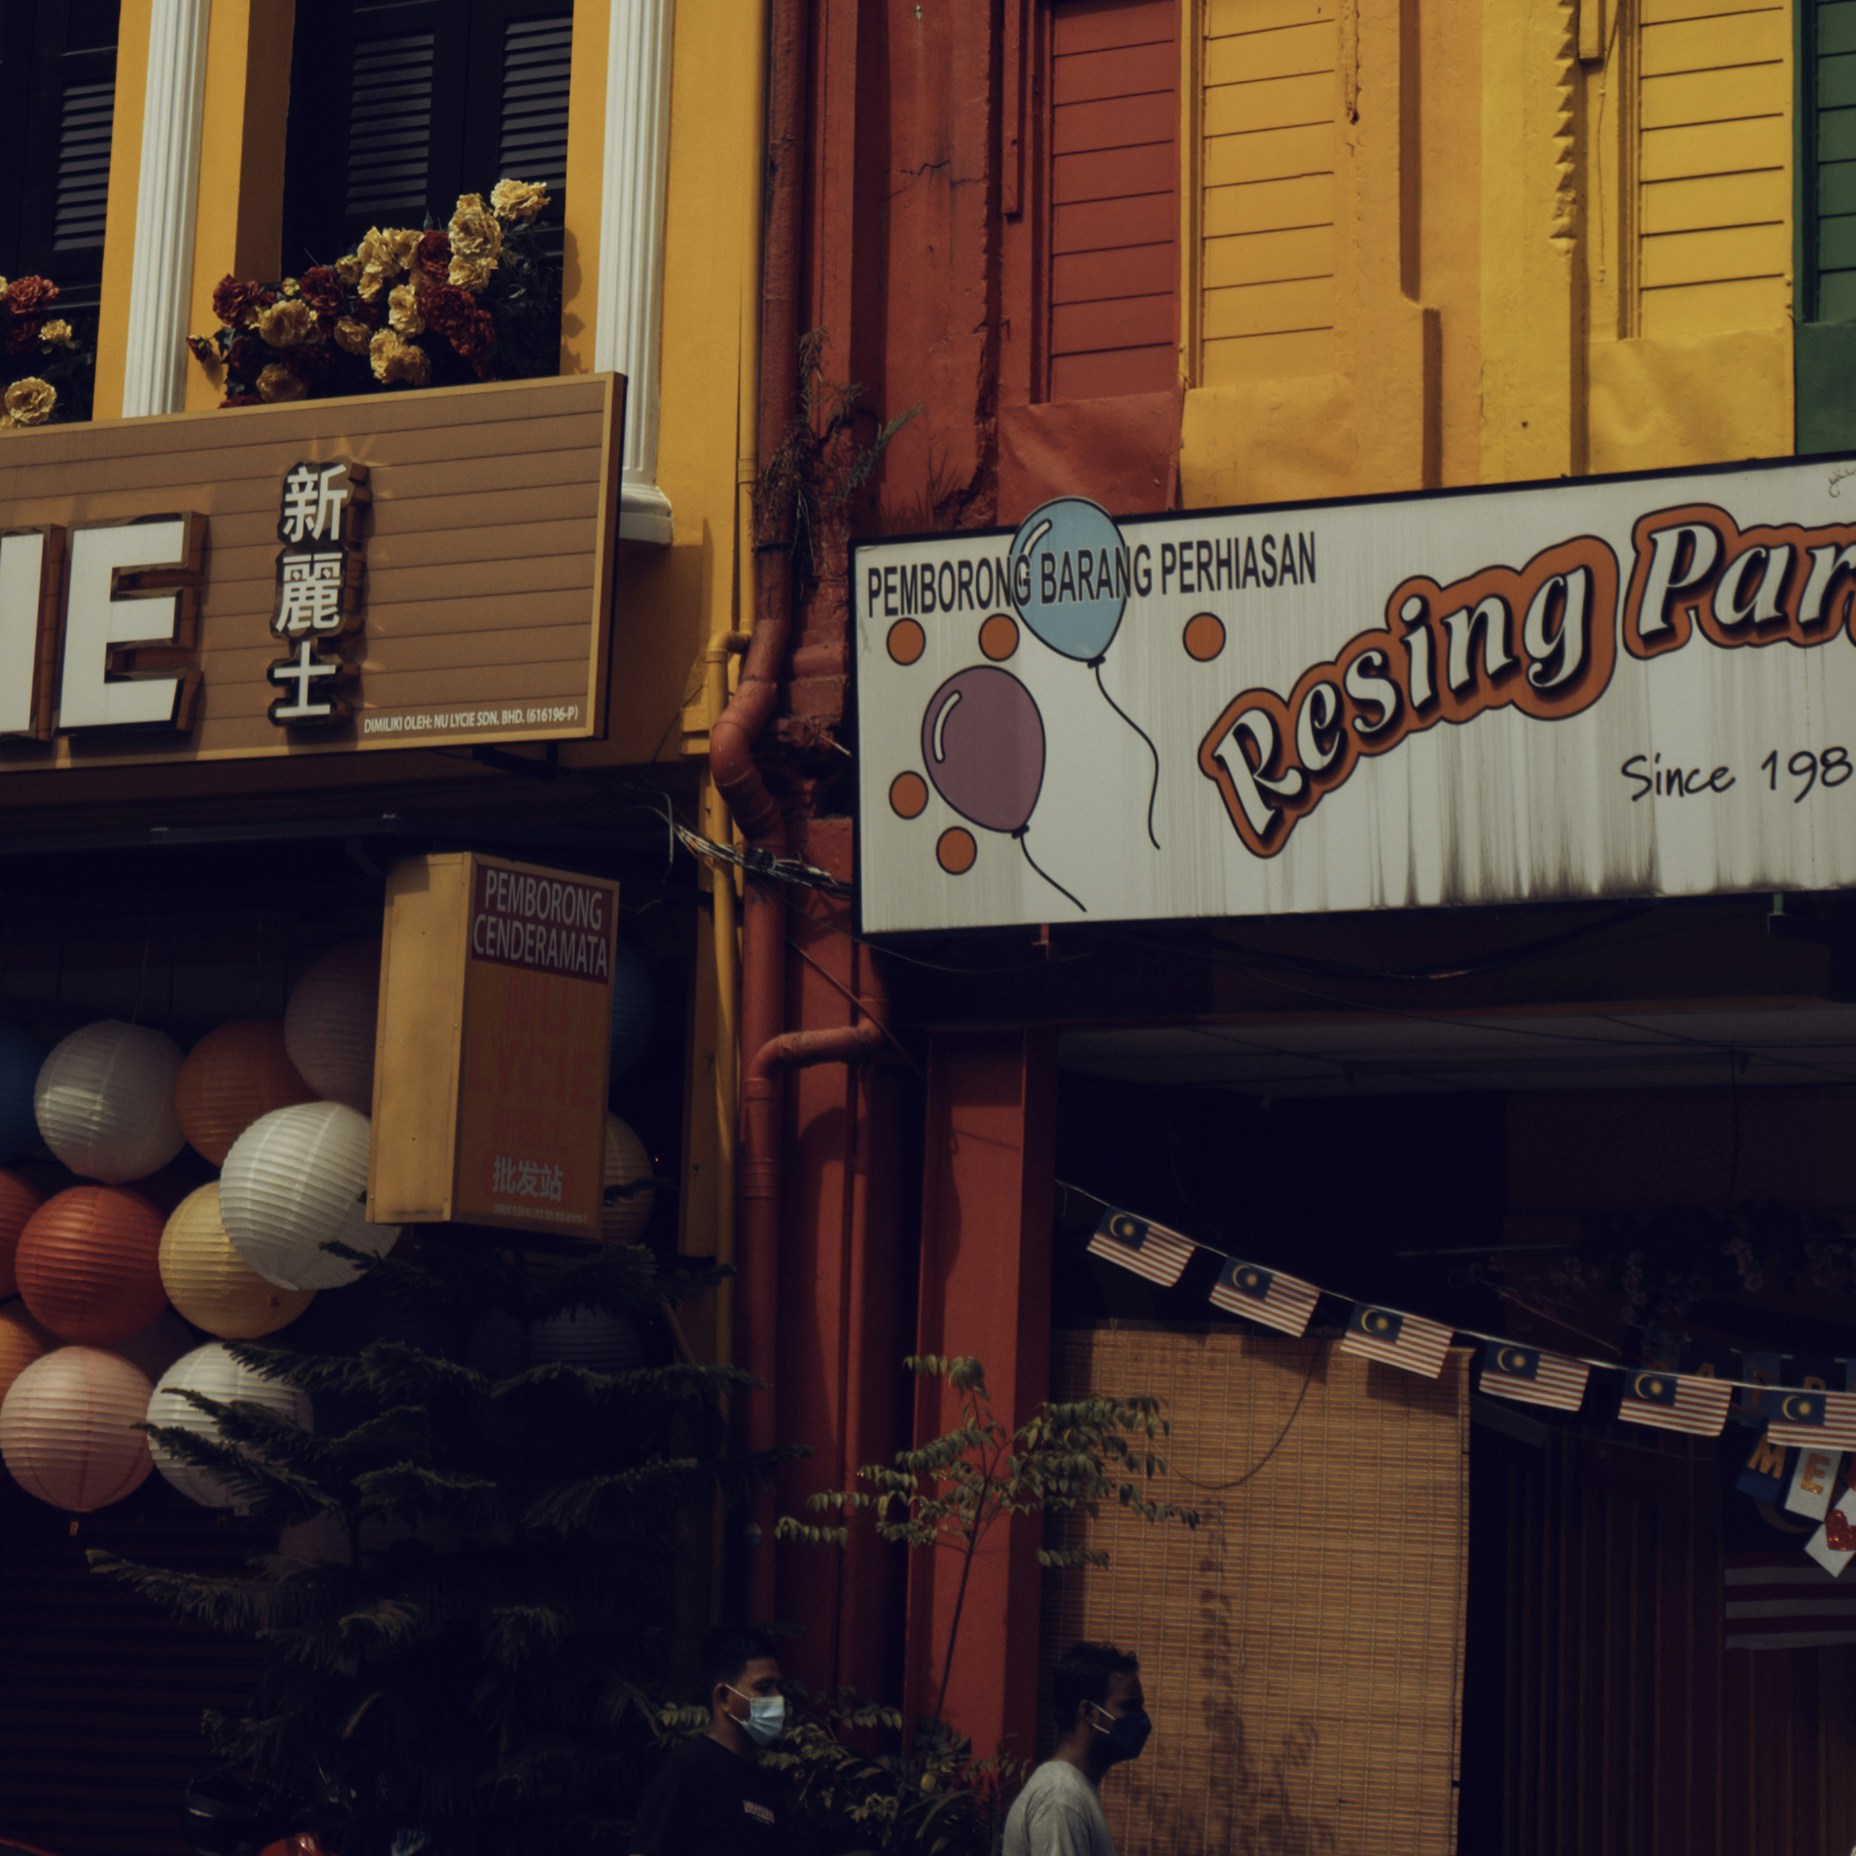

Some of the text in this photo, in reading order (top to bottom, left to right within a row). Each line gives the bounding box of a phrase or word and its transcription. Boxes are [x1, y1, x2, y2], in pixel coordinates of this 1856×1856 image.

[268, 462, 350, 724] 新麗士
[867, 531, 1317, 619] PEMBORONG BARANG PERHIASAN
[364, 716, 403, 734] DIMILIKI
[404, 714, 433, 731] OLEH:
[434, 713, 448, 729] NU
[449, 711, 477, 728] LYCIE
[477, 709, 500, 726] SDN.
[501, 708, 524, 724] BHD.
[1211, 564, 1592, 840] Resing
[1620, 750, 1736, 802] Since
[484, 869, 603, 931] PEMBORONG
[473, 913, 609, 978] CENDERAMATA
[503, 972, 571, 1038] NU
[467, 1031, 597, 1112] LYCIE
[492, 1154, 564, 1204] 批发站
